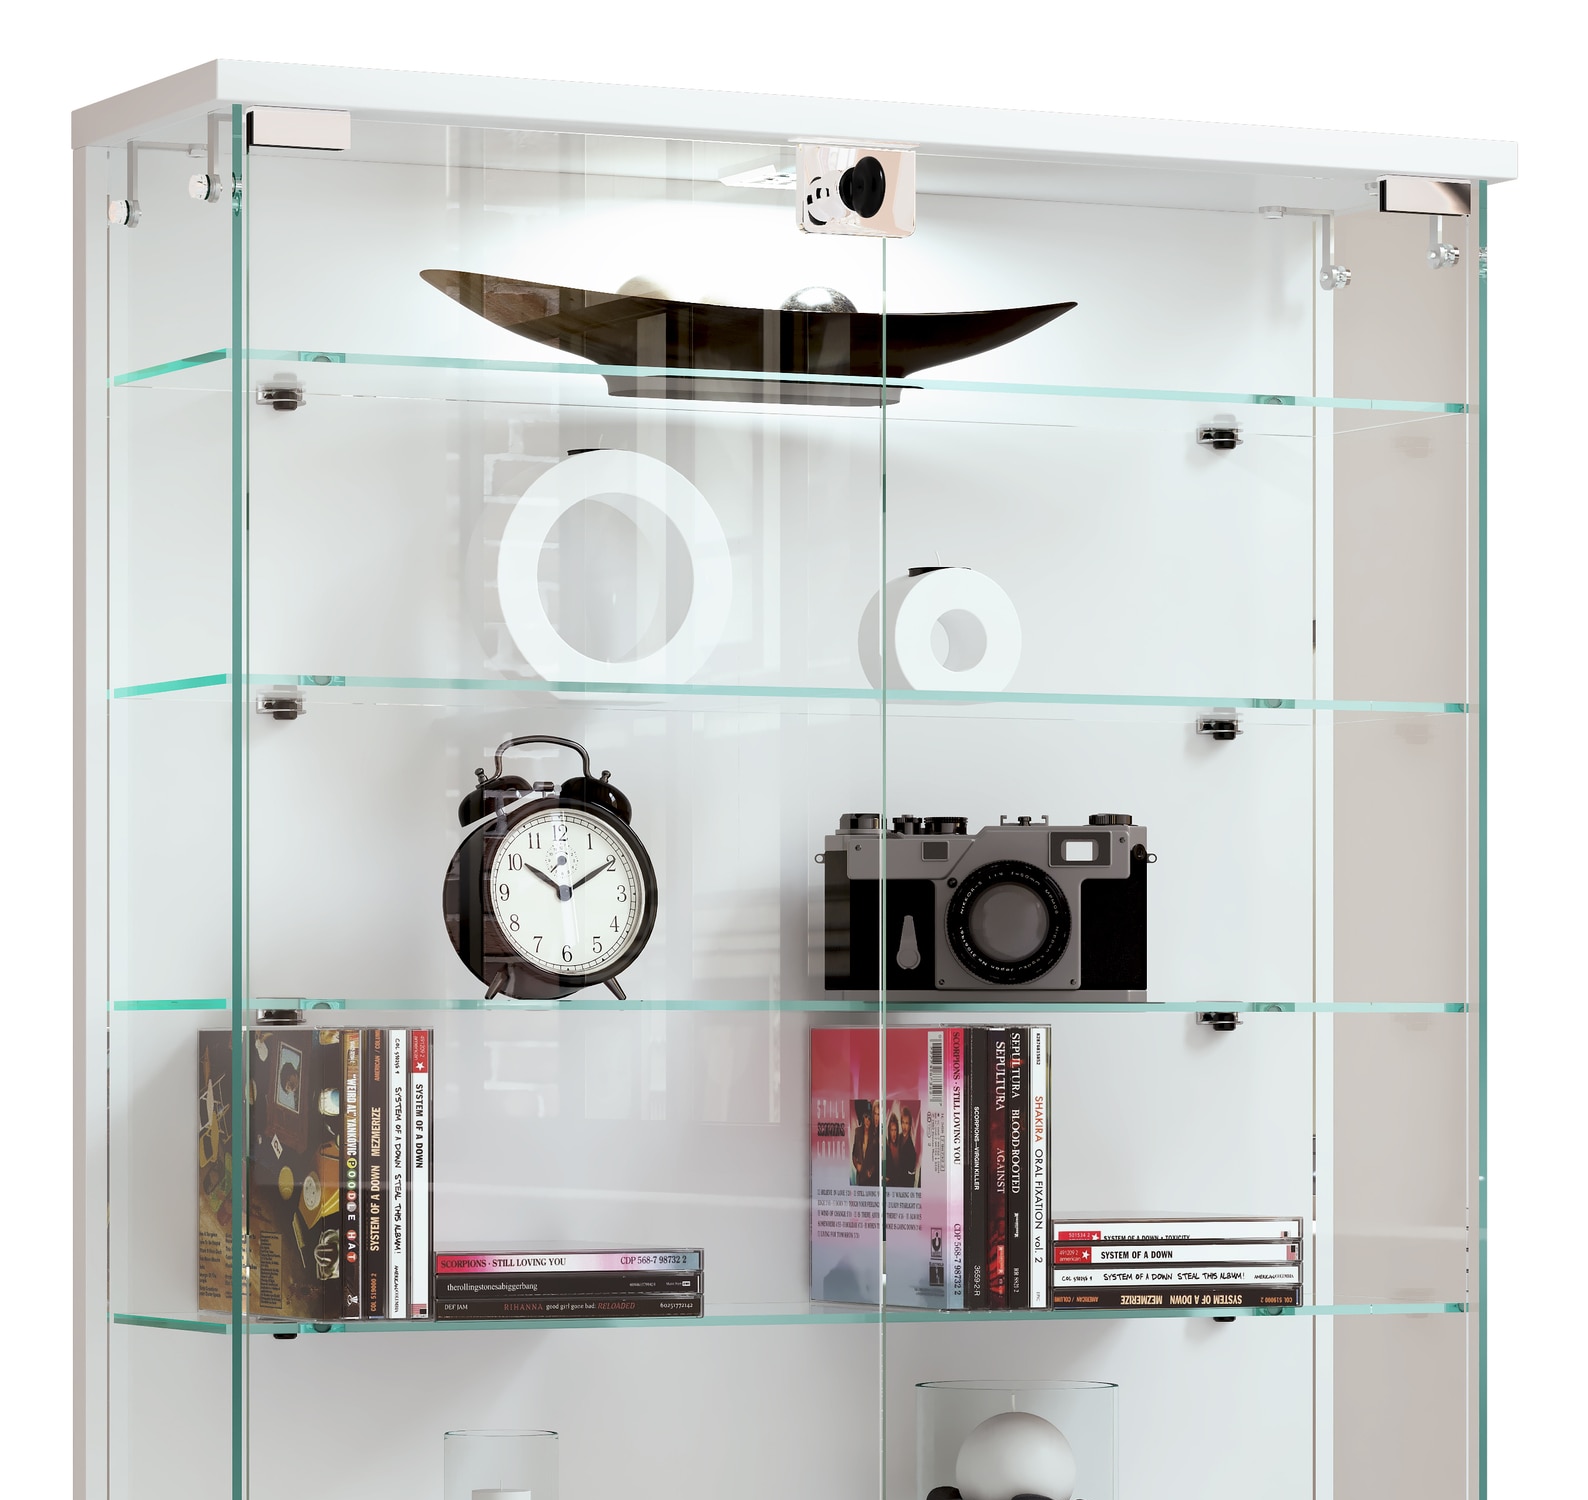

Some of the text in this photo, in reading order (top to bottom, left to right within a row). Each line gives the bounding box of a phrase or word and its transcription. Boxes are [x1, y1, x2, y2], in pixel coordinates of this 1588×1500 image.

[528, 832, 540, 849] 11
[552, 824, 568, 841] 12
[586, 833, 593, 850] 1
[508, 853, 523, 871] 10
[606, 854, 616, 872] 2
[499, 884, 510, 901] 9
[616, 885, 627, 902] 3
[509, 914, 520, 931] 8
[609, 916, 620, 932] 4
[533, 936, 543, 953] 7
[562, 945, 573, 962] 6
[592, 936, 603, 953] 5
[1011, 1032, 1021, 1099] SEPULTURA
[394, 1086, 402, 1122] SYSTEM
[415, 1084, 424, 1117] SYSTEM
[415, 1120, 424, 1133] OF
[995, 1041, 1006, 1194] SEPULTURA AGAINST
[346, 1117, 356, 1156] YANKOVIC
[371, 1107, 381, 1157] MEZMERIZE
[952, 1031, 961, 1240] SCORPIONS STILL LOVING YOU CDP
[394, 1143, 402, 1169] DOWN
[415, 1142, 424, 1169] DOWN
[1011, 1109, 1021, 1194] BLOOD-ROOTED
[370, 1165, 380, 1192] DOWN
[1034, 1095, 1044, 1253] SHAKIRA ORAL FIXATION vol.
[347, 1159, 357, 1221] POODLE
[394, 1174, 402, 1201] STEAL
[370, 1202, 380, 1215] OF
[394, 1203, 402, 1222] THIS
[370, 1217, 380, 1252] SYSTEM
[347, 1231, 357, 1260] HAT
[440, 1255, 681, 1269] SCORPIONS STILL LOVING YOU CDP 568-7 98732
[1101, 1250, 1173, 1260] SYSTEM OF A DOWN
[1103, 1272, 1218, 1281] SYSTEM OF DOWN STEAL THIS
[447, 1282, 538, 1292] therollingstonesabiggerbang
[504, 1303, 544, 1311] RIHANNA
[545, 1303, 560, 1311] good
[560, 1302, 570, 1311] girl
[597, 1302, 635, 1310] RELOADED
[1120, 1295, 1243, 1305] SYSTEM OF DOWN MEZMERIZE
